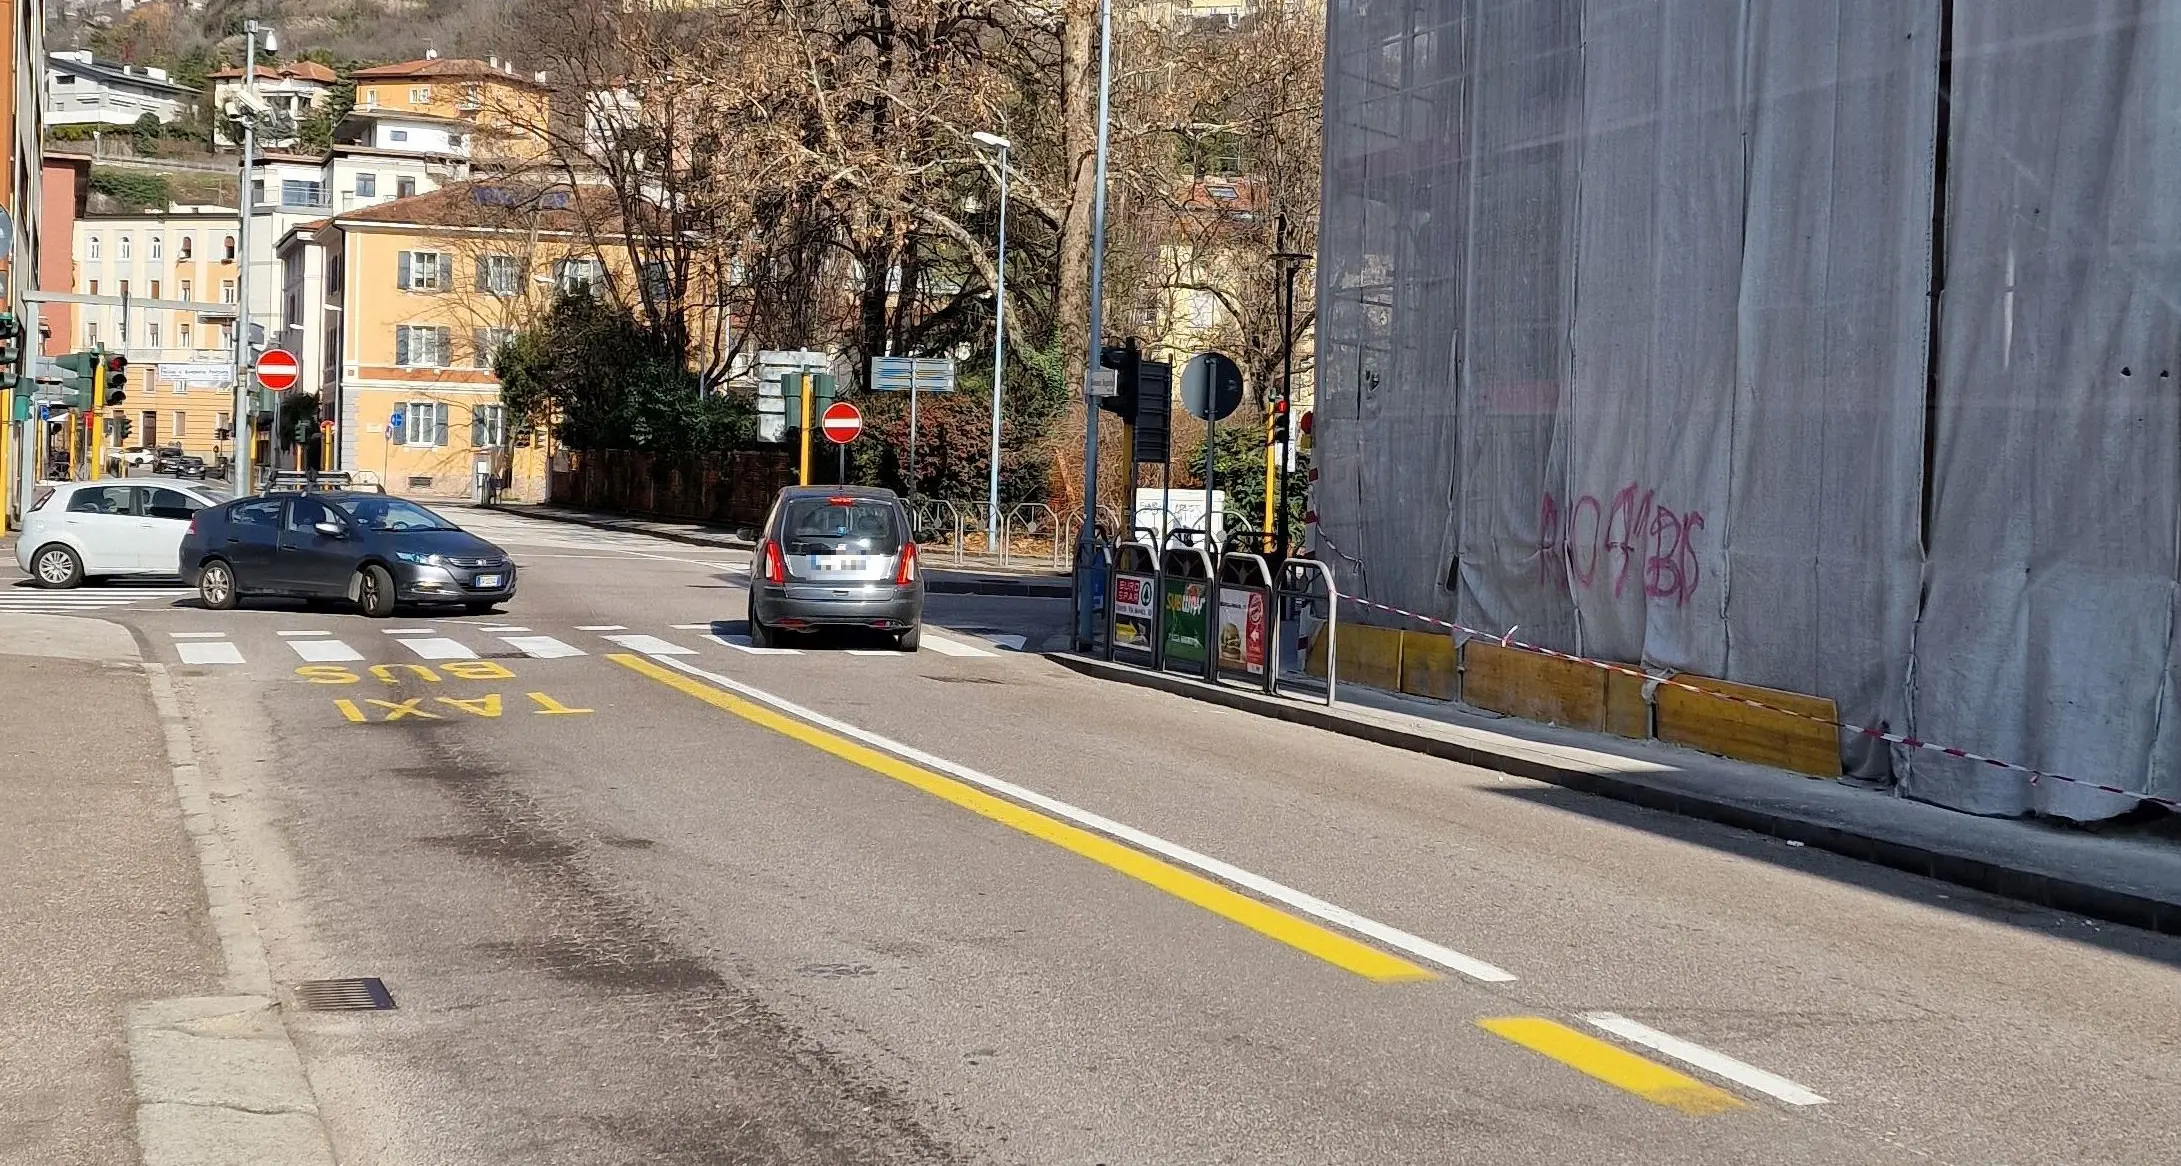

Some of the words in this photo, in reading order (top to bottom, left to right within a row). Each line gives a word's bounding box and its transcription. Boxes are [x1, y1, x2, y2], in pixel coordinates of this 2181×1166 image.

[1119, 580, 1140, 592] EURO
[1118, 590, 1139, 602] SPAR
[294, 661, 517, 684] BUS
[333, 692, 596, 722] TAXI
